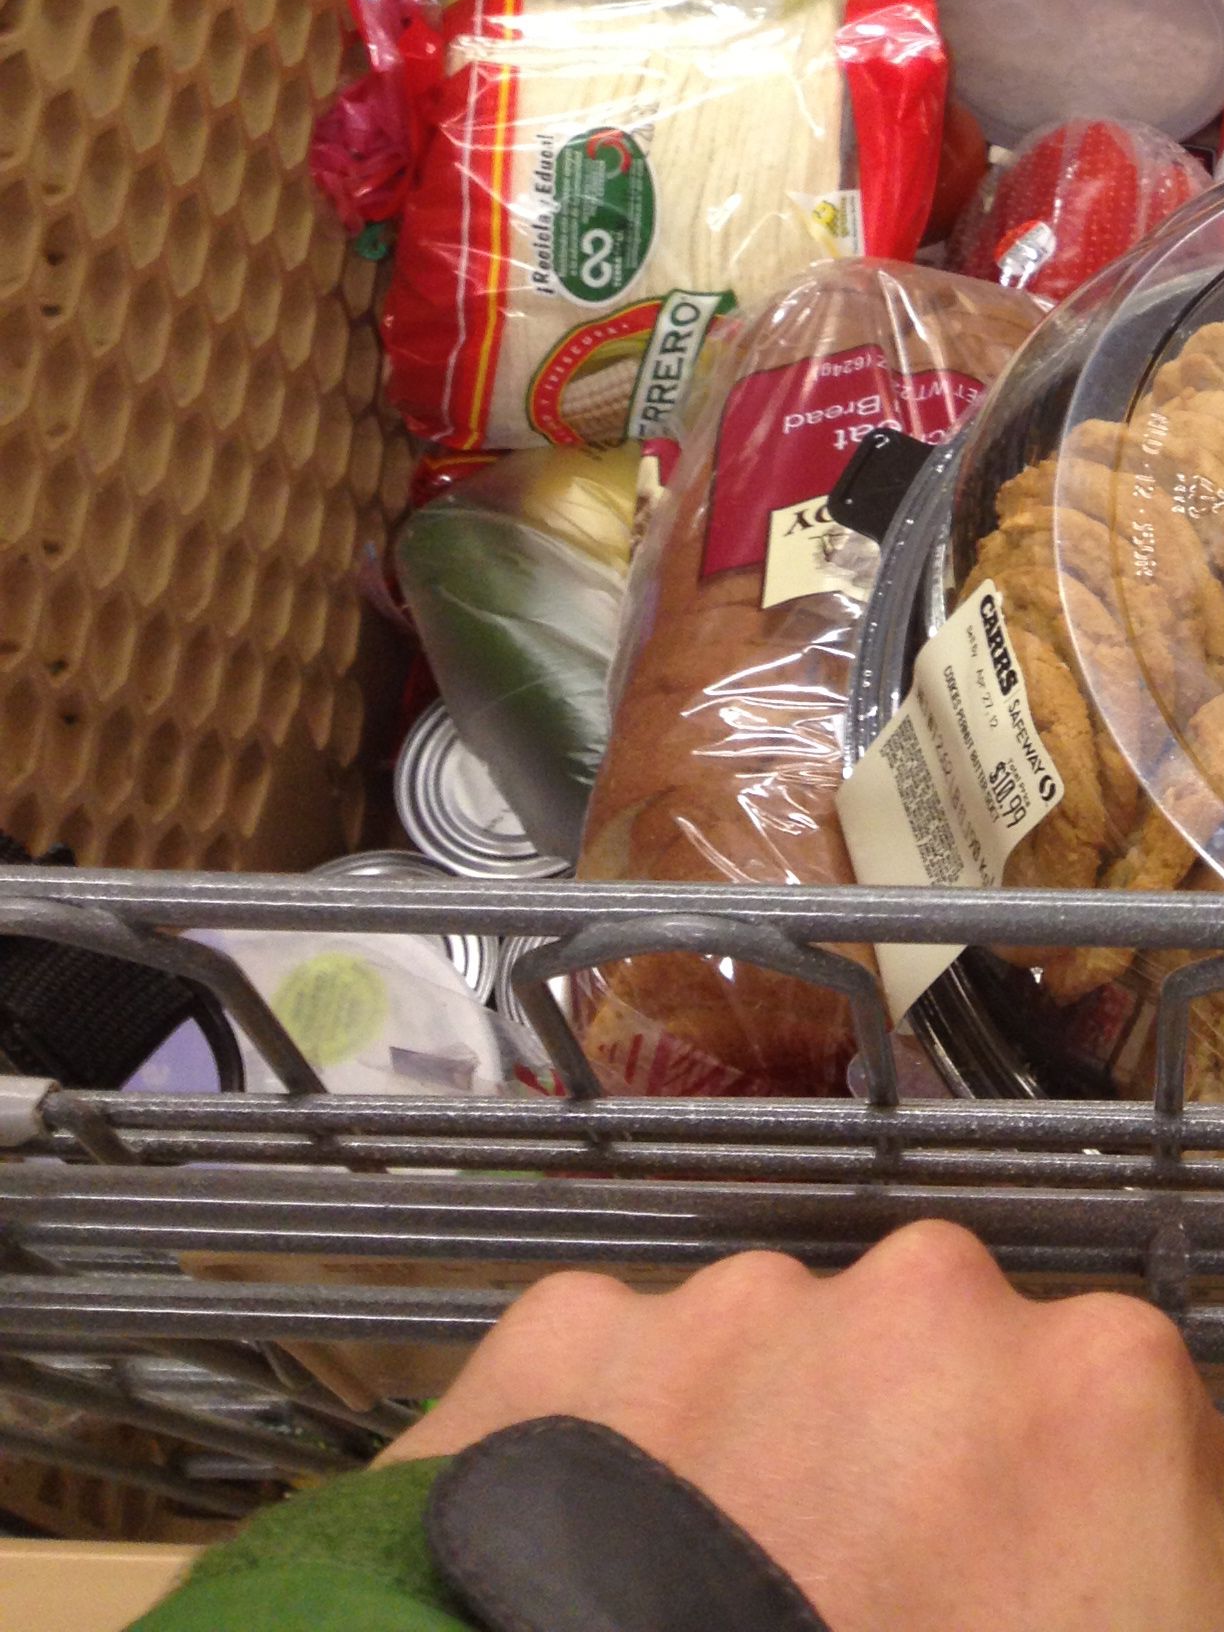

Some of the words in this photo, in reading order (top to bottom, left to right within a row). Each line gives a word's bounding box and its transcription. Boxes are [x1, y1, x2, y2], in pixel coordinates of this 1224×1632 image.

[782, 394, 882, 435] Bread
[980, 594, 1019, 697] CARRS
[1008, 698, 1046, 776] SAFEWAY
[989, 759, 1029, 830] $10.99
[1019, 780, 1031, 808] Price
